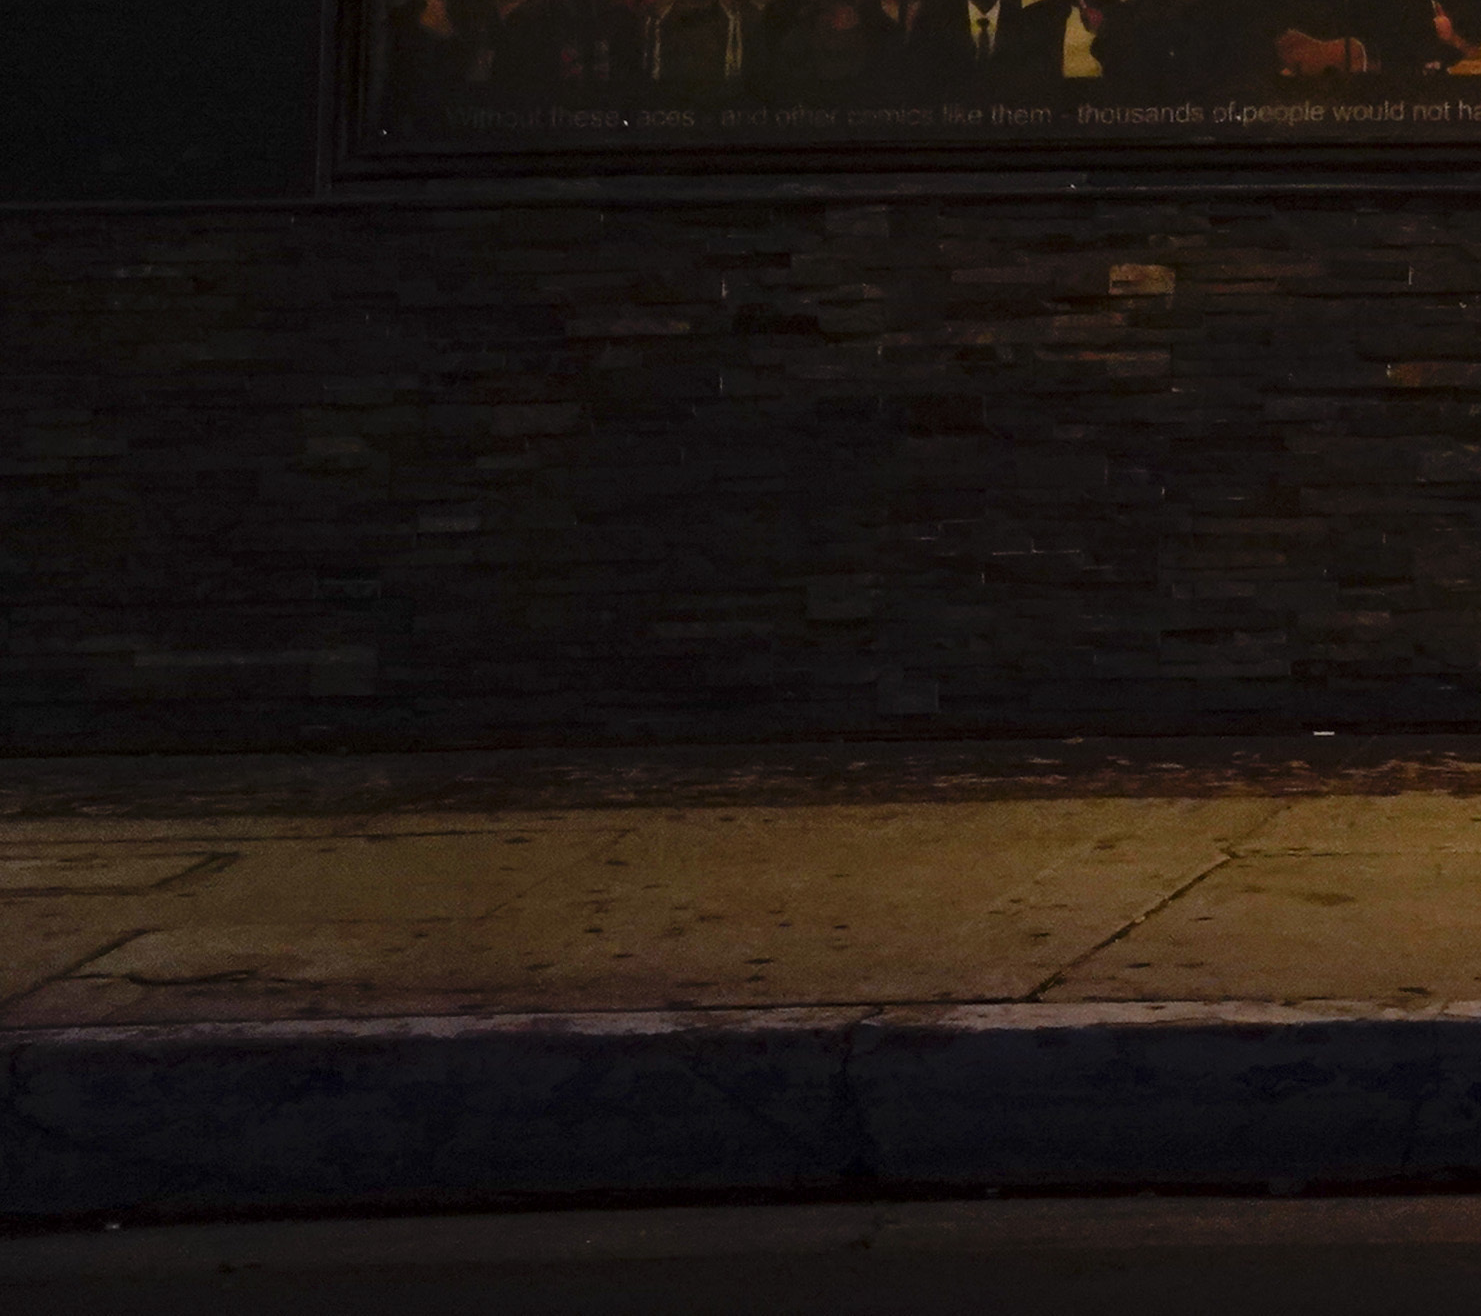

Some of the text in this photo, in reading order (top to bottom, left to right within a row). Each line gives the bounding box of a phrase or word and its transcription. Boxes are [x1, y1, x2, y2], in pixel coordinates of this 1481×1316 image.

[721, 105, 768, 127] and
[943, 103, 984, 125] like
[992, 103, 1052, 125] them
[1077, 102, 1205, 124] thousands
[1212, 101, 1235, 123] of
[1243, 101, 1325, 127] people
[1332, 100, 1406, 122] would
[1413, 101, 1450, 122] not
